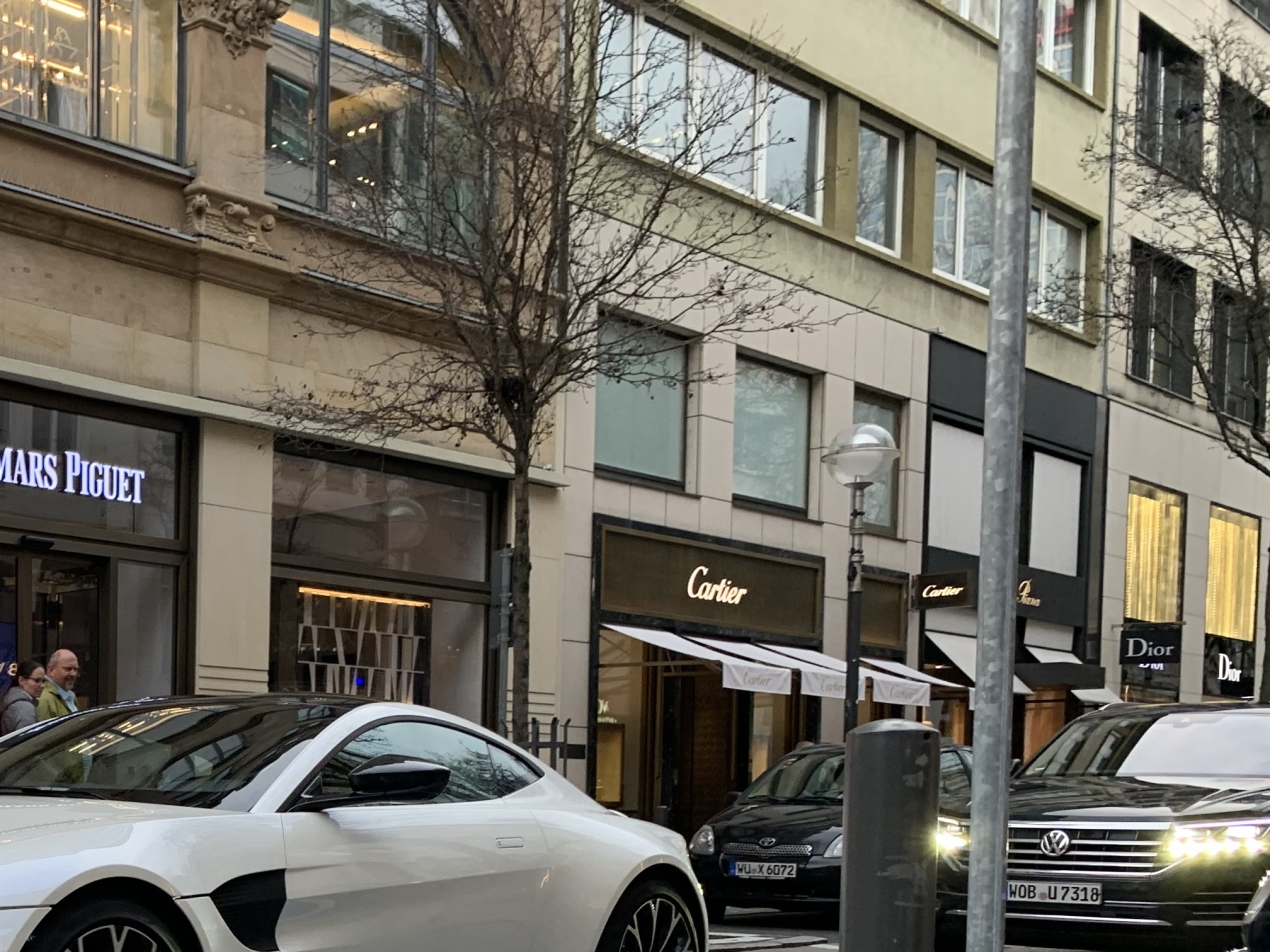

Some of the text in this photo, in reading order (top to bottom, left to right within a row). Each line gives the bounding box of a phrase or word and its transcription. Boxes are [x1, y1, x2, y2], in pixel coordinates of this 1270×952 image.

[64, 450, 145, 503] PIGUET
[687, 565, 748, 605] Cartier
[922, 584, 964, 598] Cartier
[1124, 637, 1175, 658] Dior
[743, 669, 772, 687] Cartier
[1217, 653, 1242, 682] Dior
[890, 683, 920, 701] Cartier
